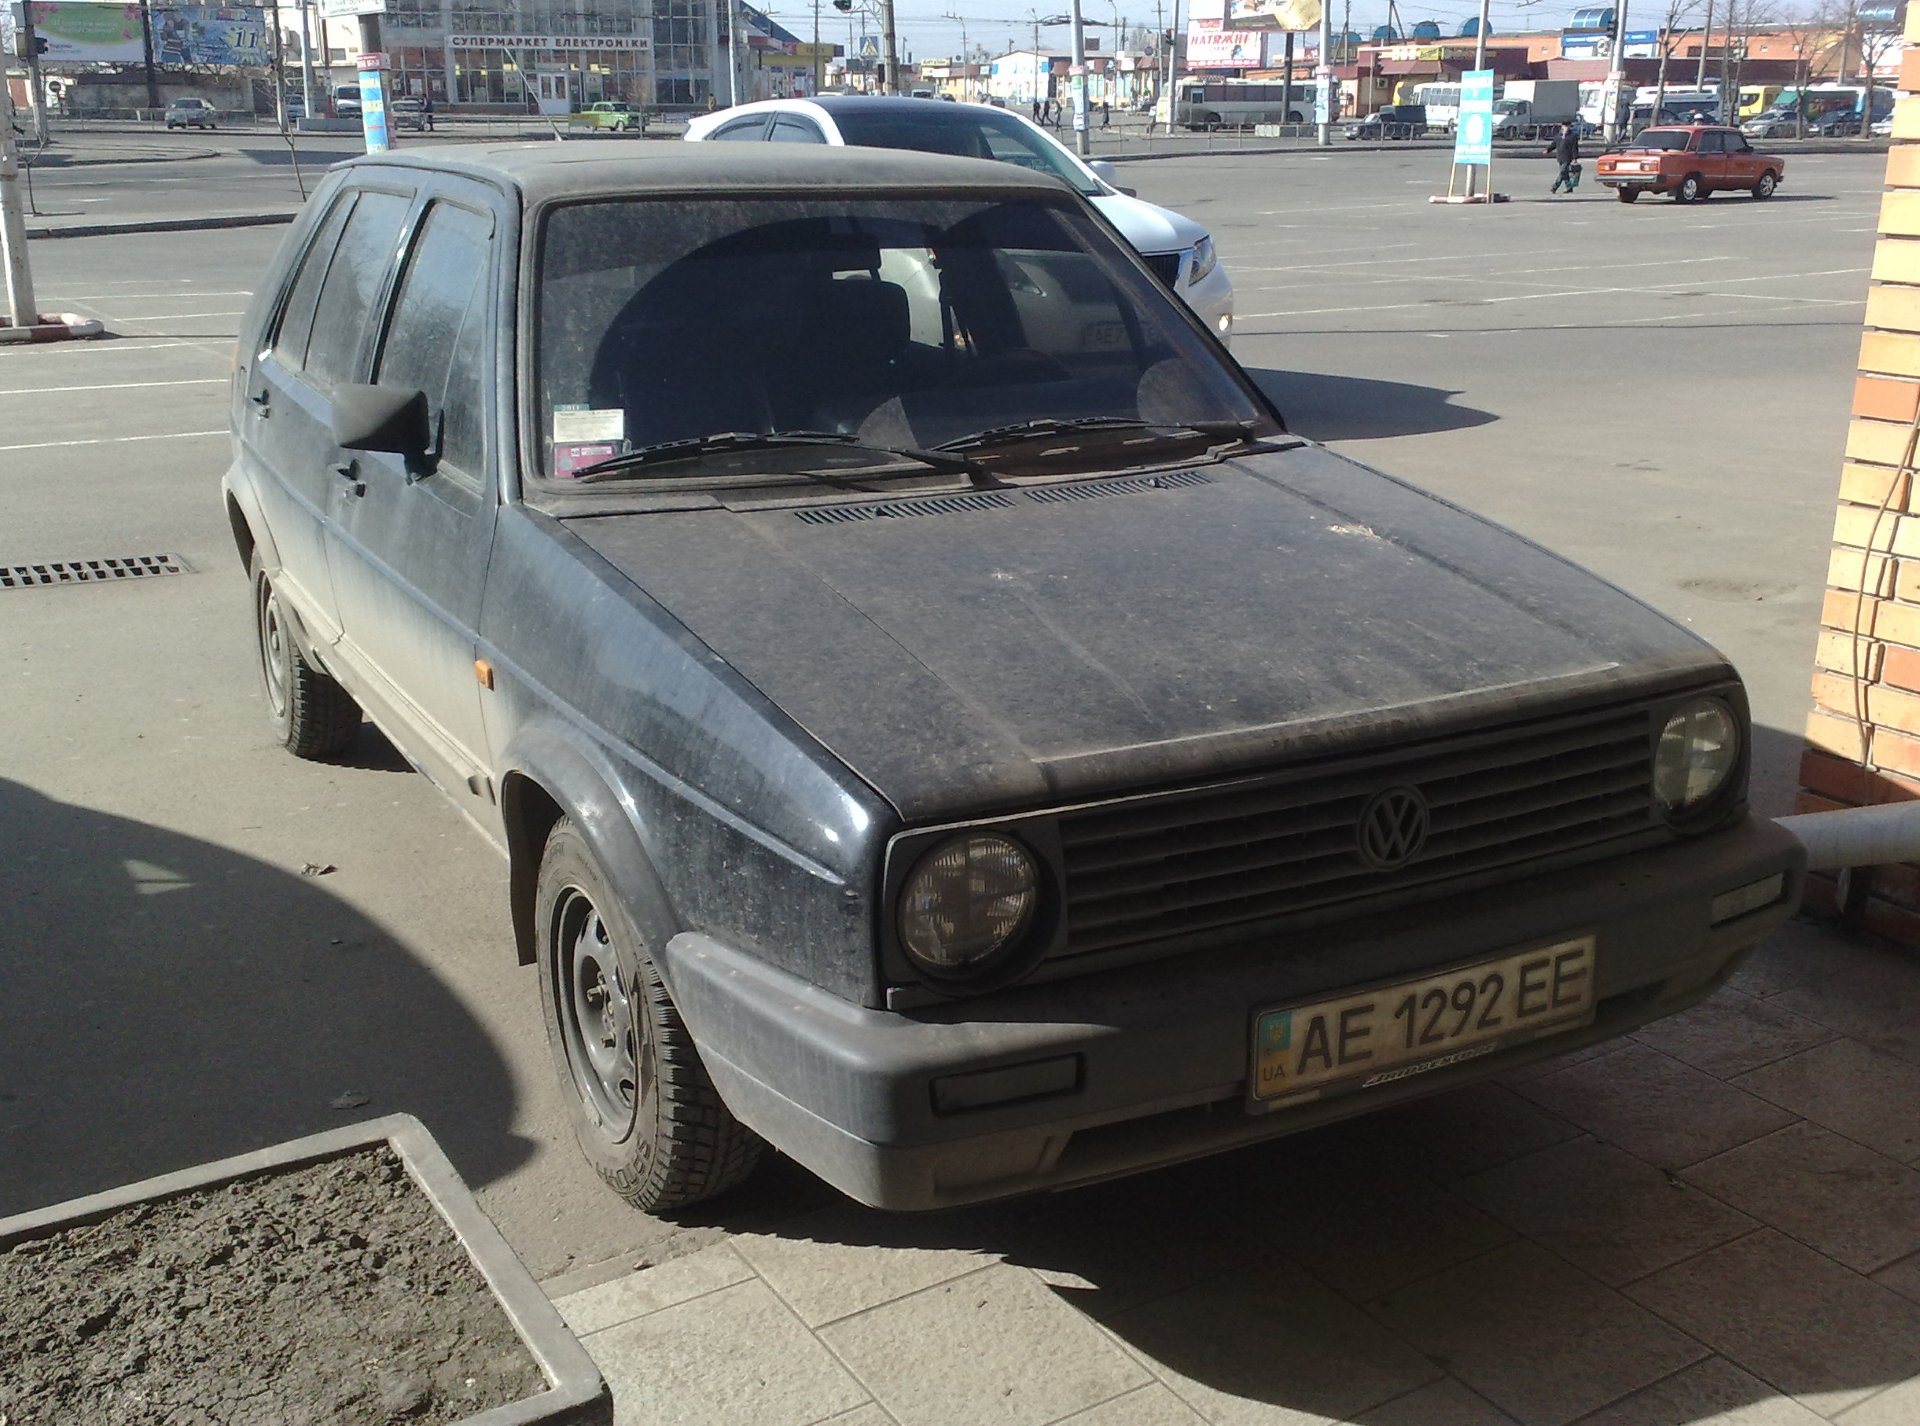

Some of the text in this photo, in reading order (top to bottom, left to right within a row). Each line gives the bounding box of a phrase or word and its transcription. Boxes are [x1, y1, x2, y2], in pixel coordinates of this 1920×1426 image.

[452, 36, 648, 48] СУПЕРМАРКЕТ ЕЛЕКТРОНІКИ
[1297, 1003, 1375, 1075] AE
[1395, 973, 1504, 1049] 1292
[1517, 948, 1586, 1018] EE
[1262, 1064, 1286, 1082] UA
